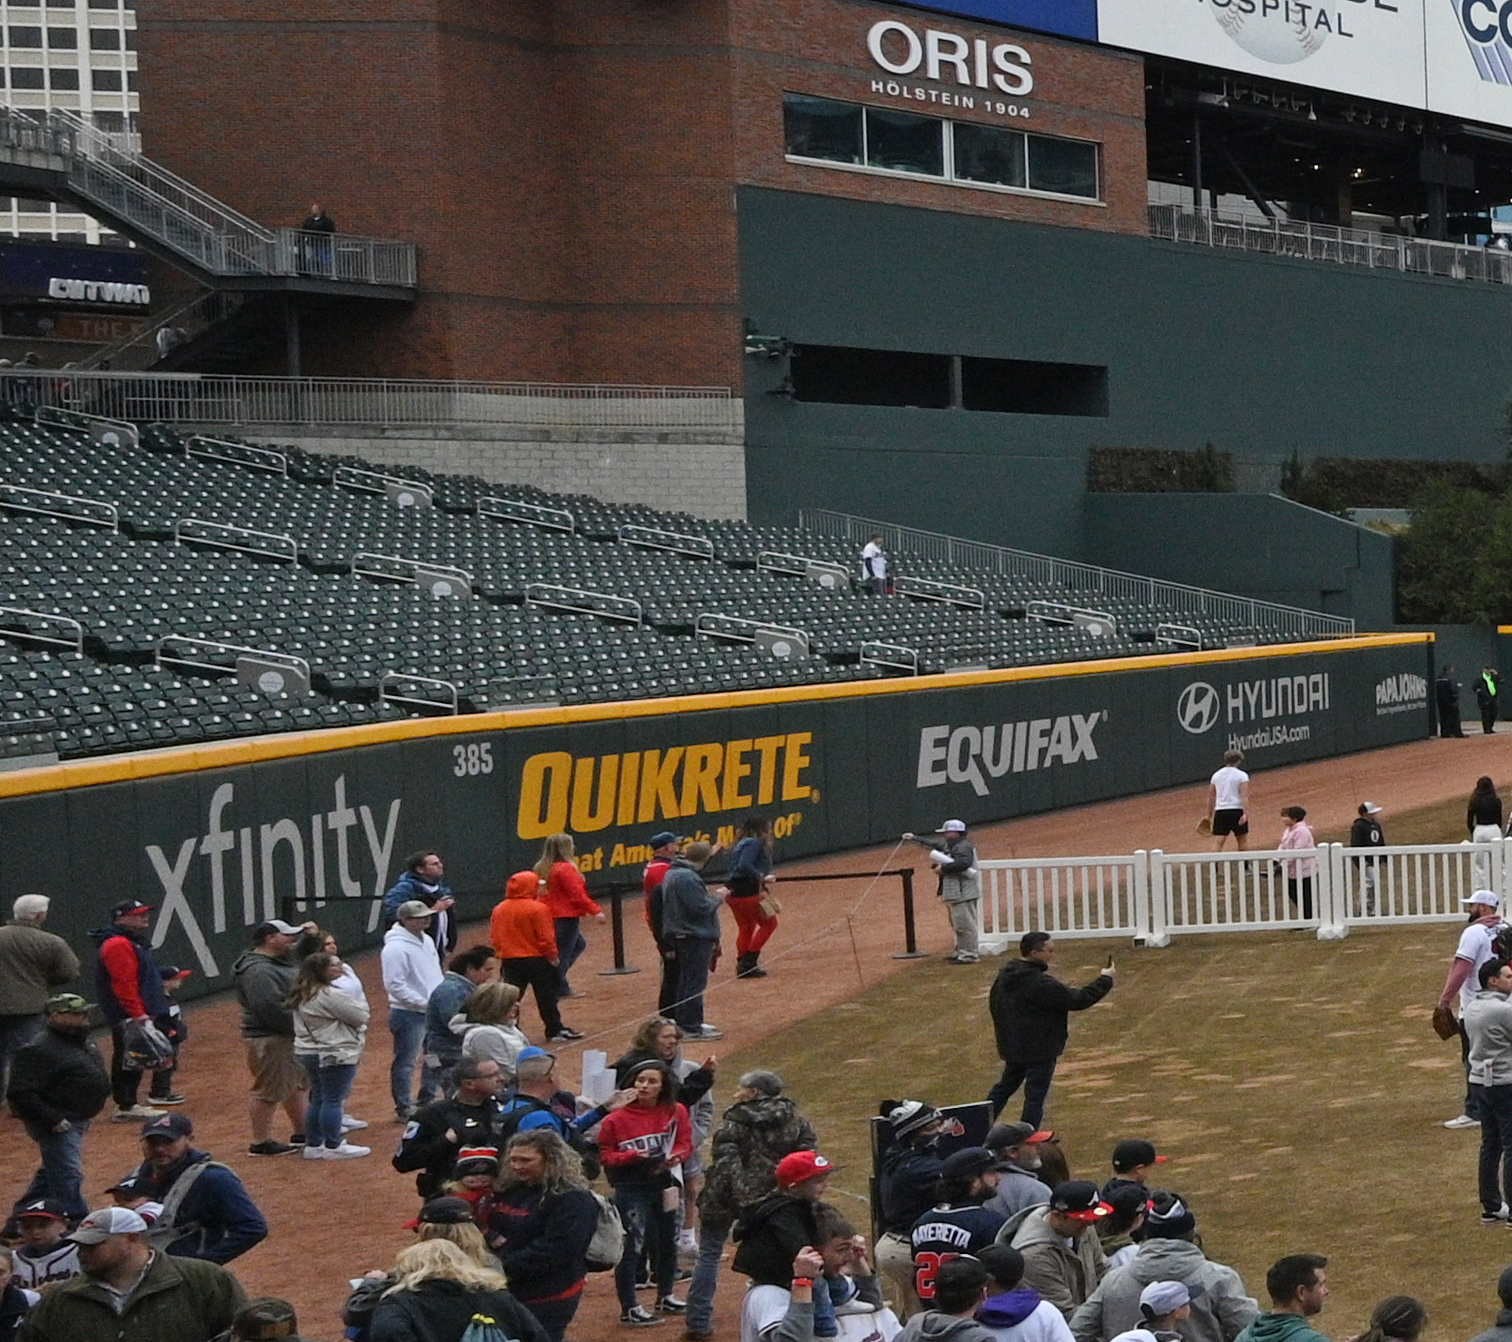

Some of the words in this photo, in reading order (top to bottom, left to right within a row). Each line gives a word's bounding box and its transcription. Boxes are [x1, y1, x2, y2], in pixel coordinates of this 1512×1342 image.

[866, 20, 1034, 97] ORIS
[870, 79, 974, 110] HÖLSTEIN
[984, 100, 1031, 120] 1904
[1226, 672, 1330, 724] HYUNDAI
[452, 741, 494, 778] 385
[516, 731, 814, 841] QUIKRETE
[916, 711, 1101, 797] EQUIFAX
[144, 772, 402, 979] xfinity
